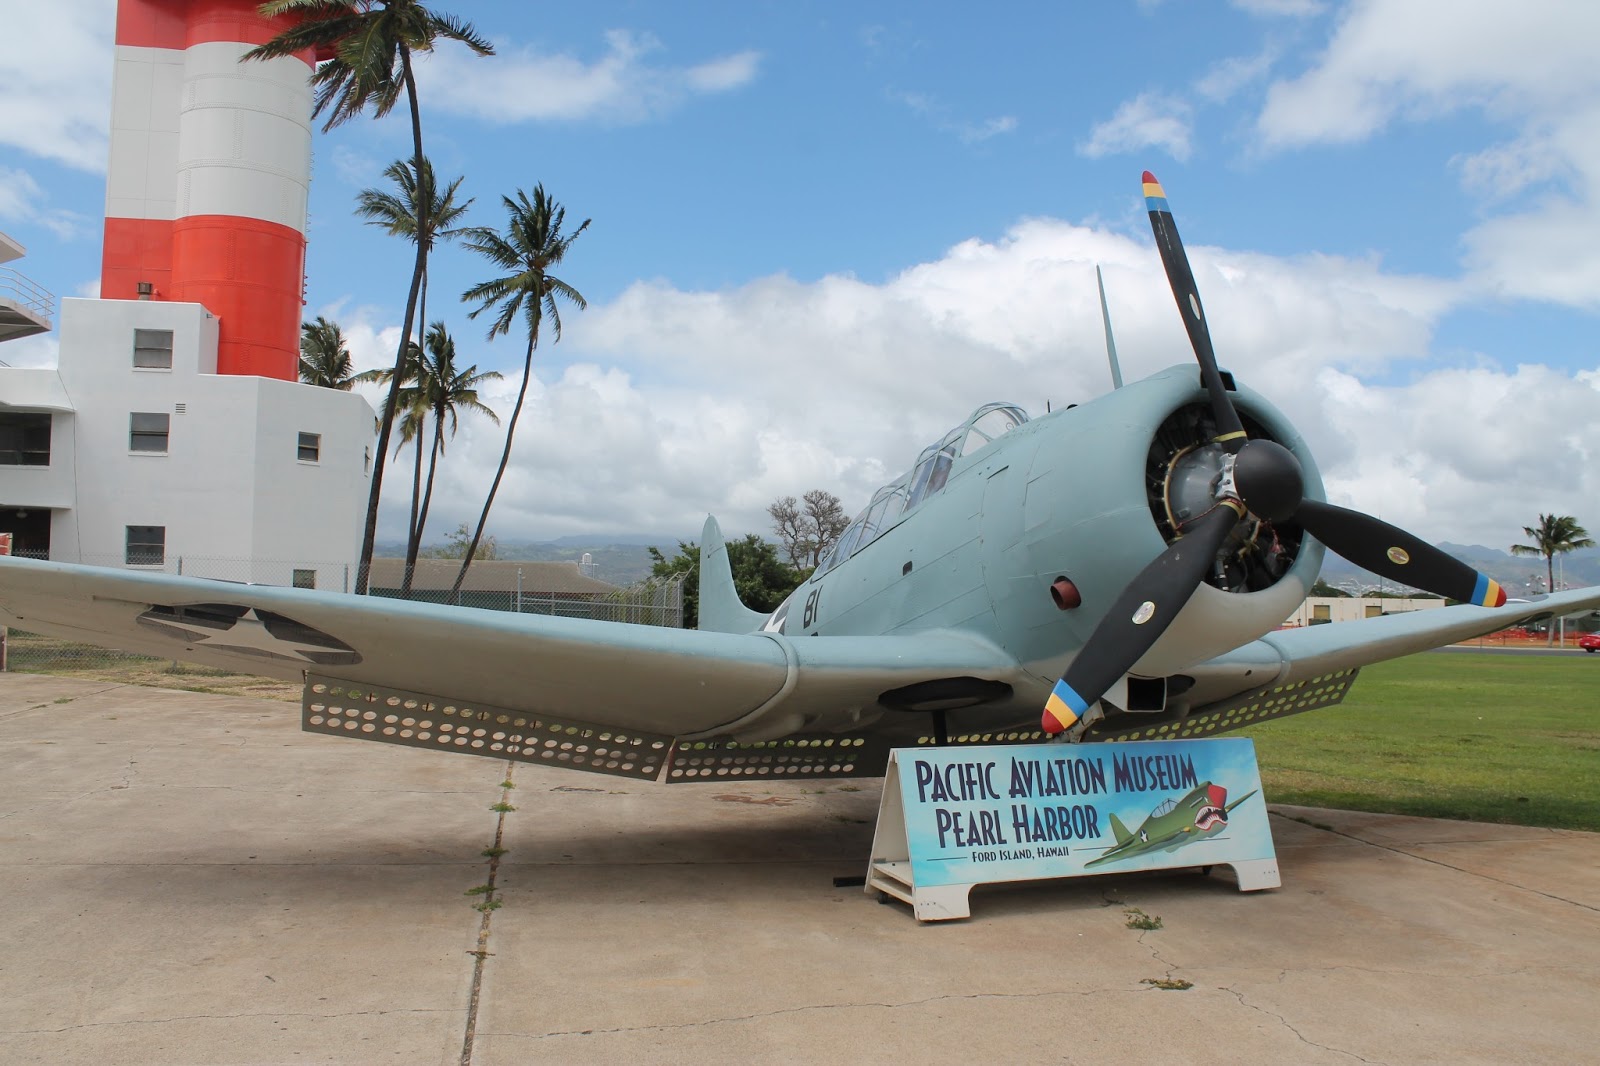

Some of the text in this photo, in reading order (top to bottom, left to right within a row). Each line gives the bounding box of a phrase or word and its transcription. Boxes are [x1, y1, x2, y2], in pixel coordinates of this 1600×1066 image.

[915, 752, 1198, 803] PACIFIC AVIATION MUSEUM
[935, 804, 1101, 848] PEARL HARBOR
[972, 847, 1069, 862] FORD ISLAND, HAWAII
